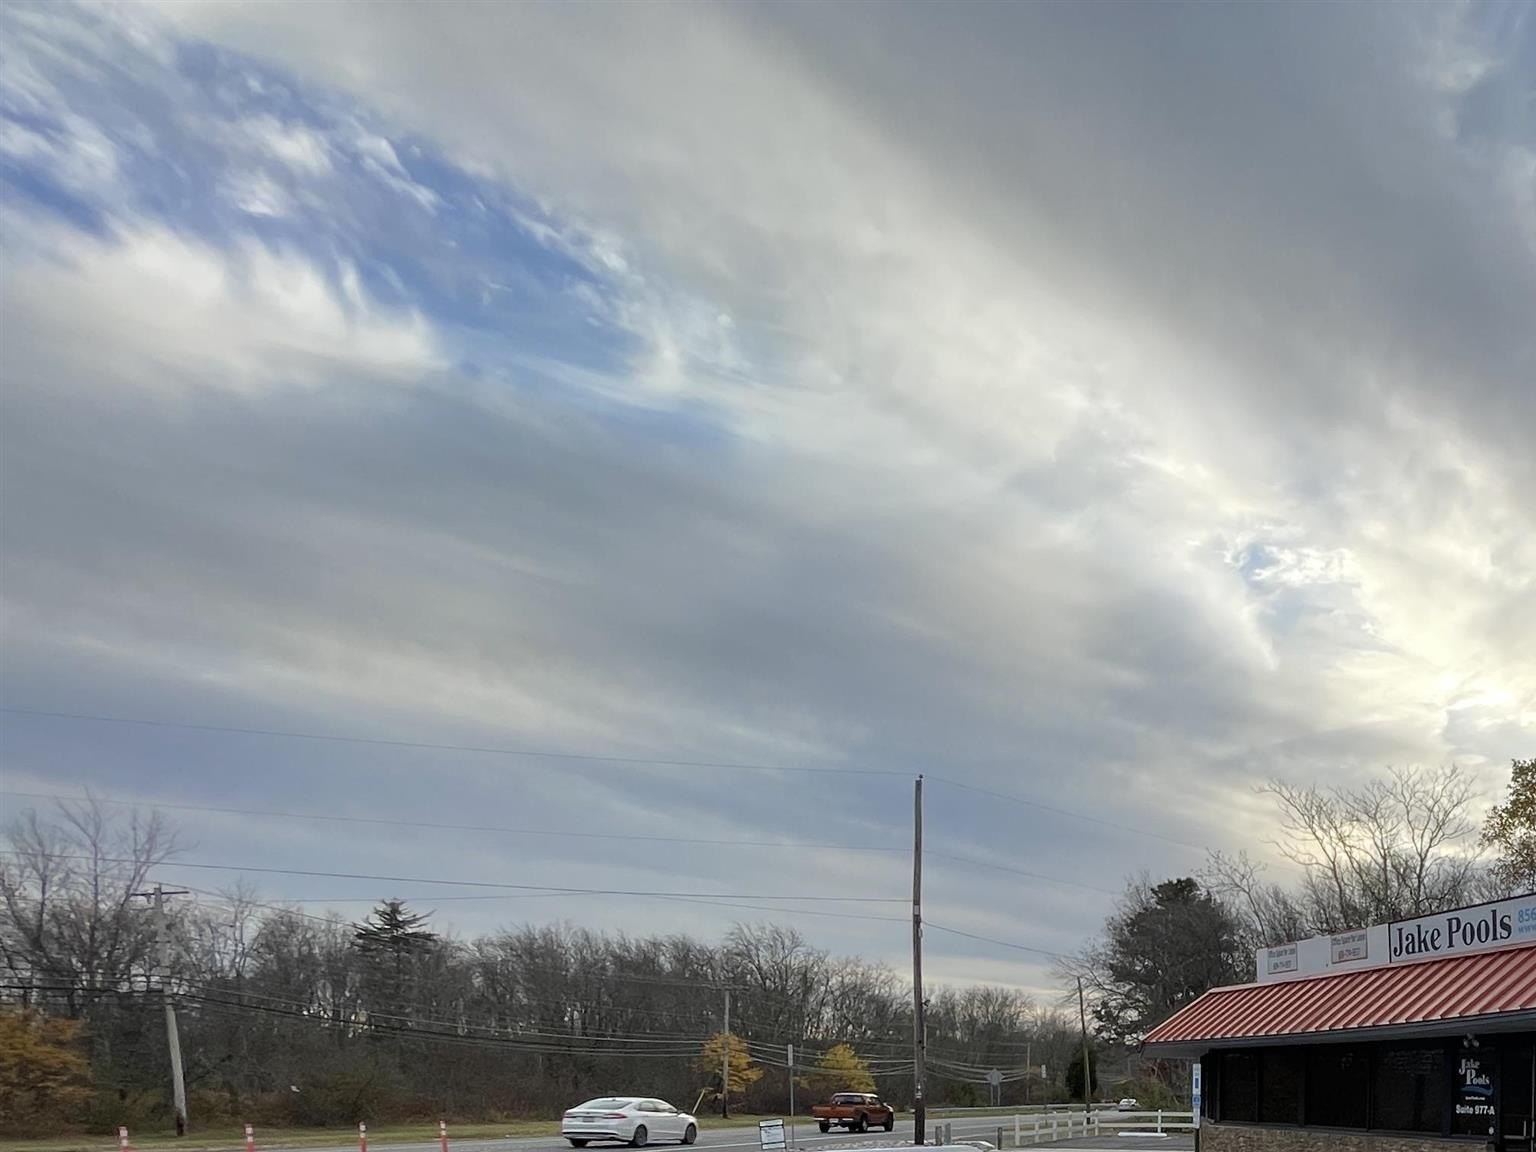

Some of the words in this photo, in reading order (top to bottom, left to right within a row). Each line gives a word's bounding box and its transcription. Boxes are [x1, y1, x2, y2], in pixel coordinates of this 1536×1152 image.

[1393, 924, 1441, 957] Jake
[1446, 909, 1512, 948] Pools
[1458, 1058, 1480, 1075] Jake
[1465, 1069, 1490, 1085] Pools
[1455, 1104, 1474, 1114] Suite
[1474, 1105, 1496, 1115] 977-A
